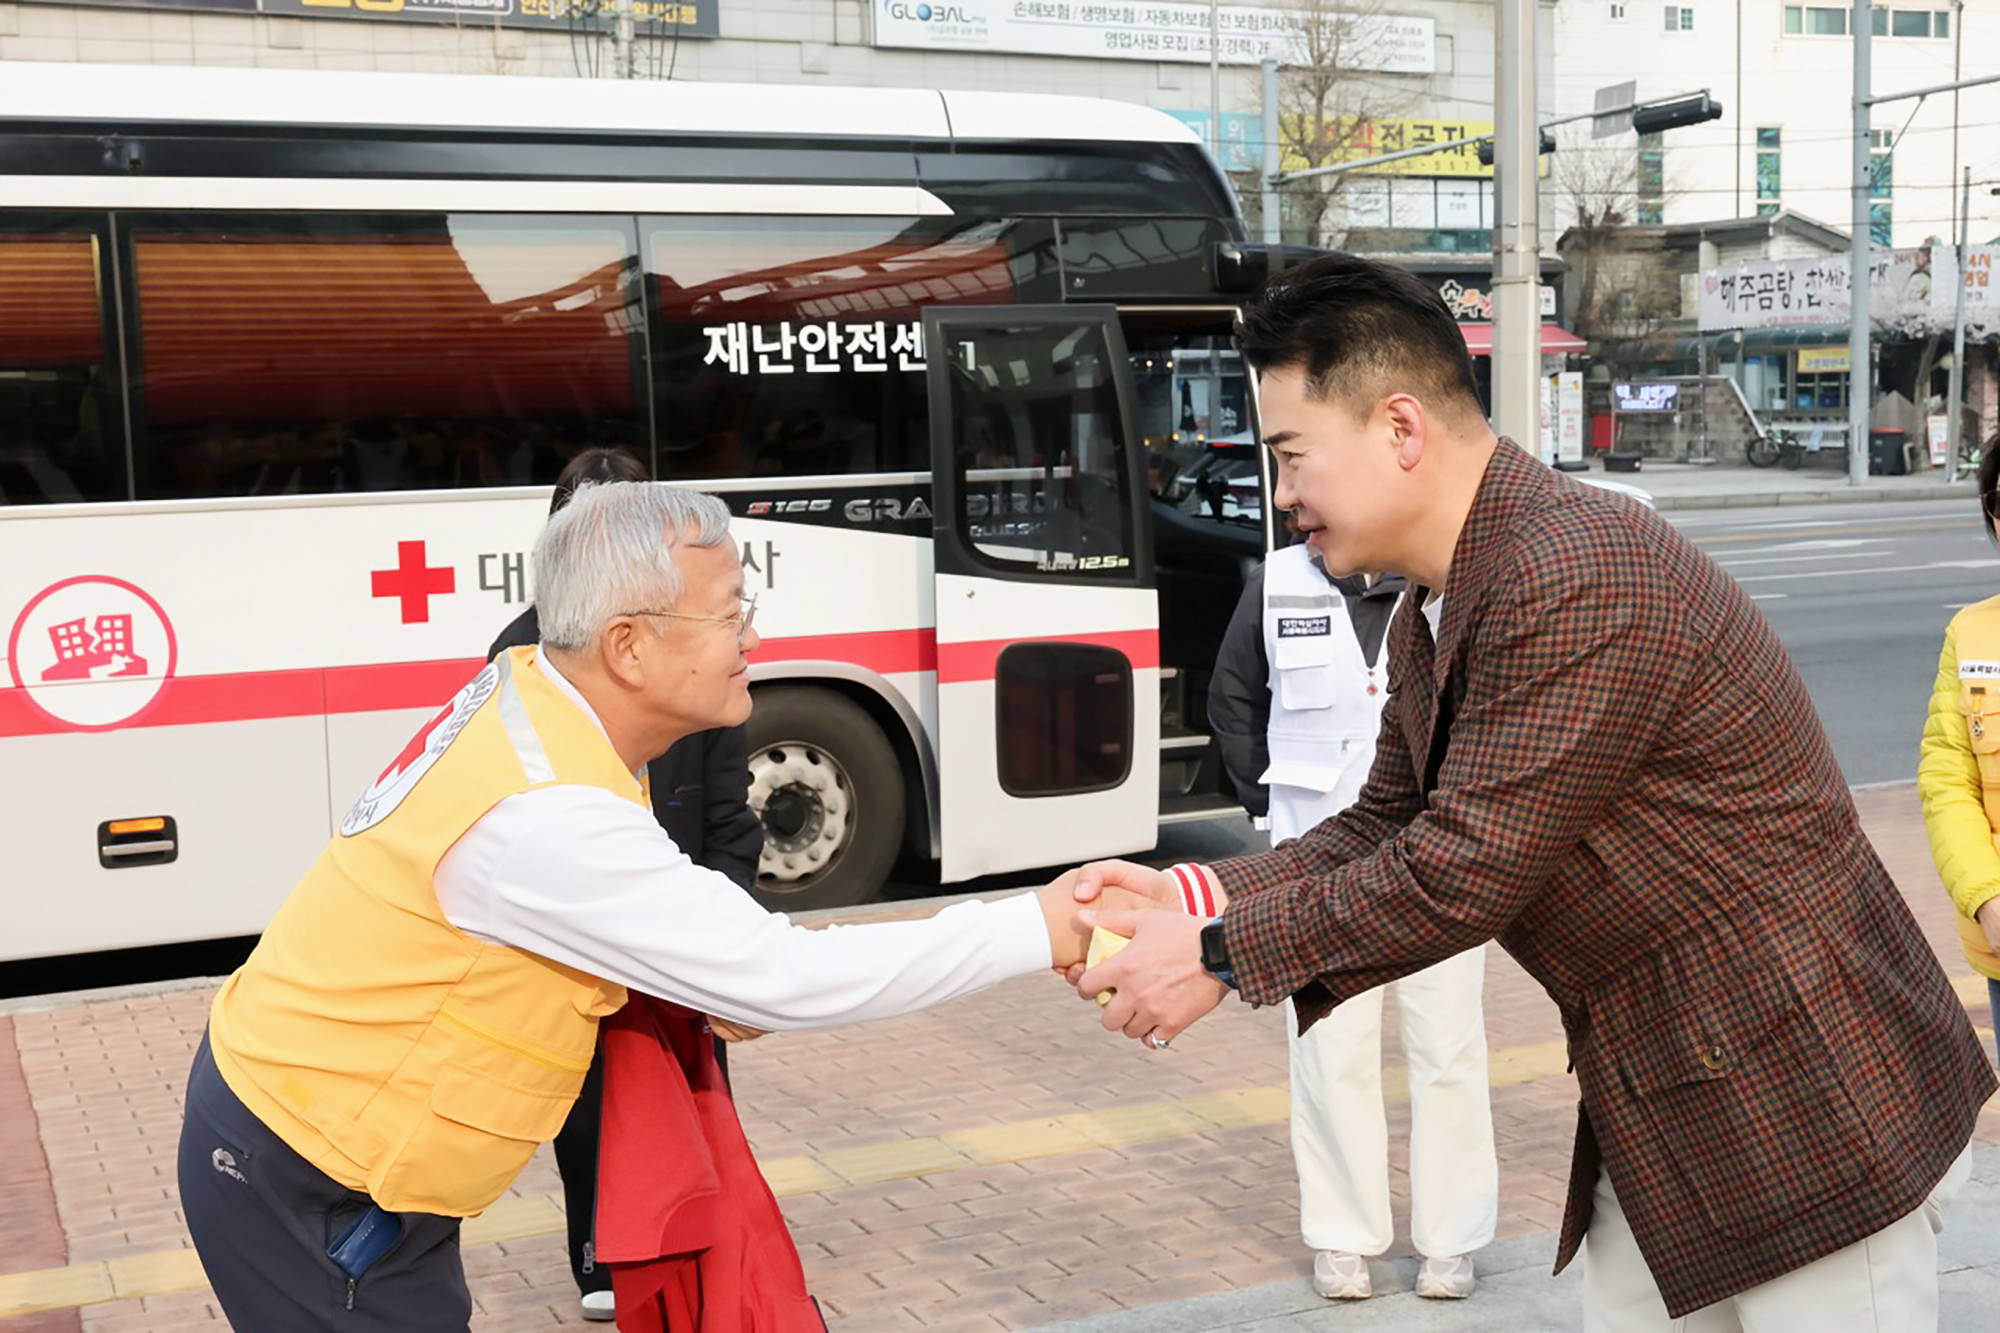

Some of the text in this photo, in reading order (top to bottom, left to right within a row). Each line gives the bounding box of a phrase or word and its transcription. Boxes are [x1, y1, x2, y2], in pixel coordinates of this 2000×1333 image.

[1014, 1, 1070, 20] 손해보험
[1081, 4, 1135, 24] 생명보험
[1145, 9, 1211, 28] 자동차보험
[1105, 31, 1159, 50] 영업사원
[1162, 35, 1188, 51] 모집
